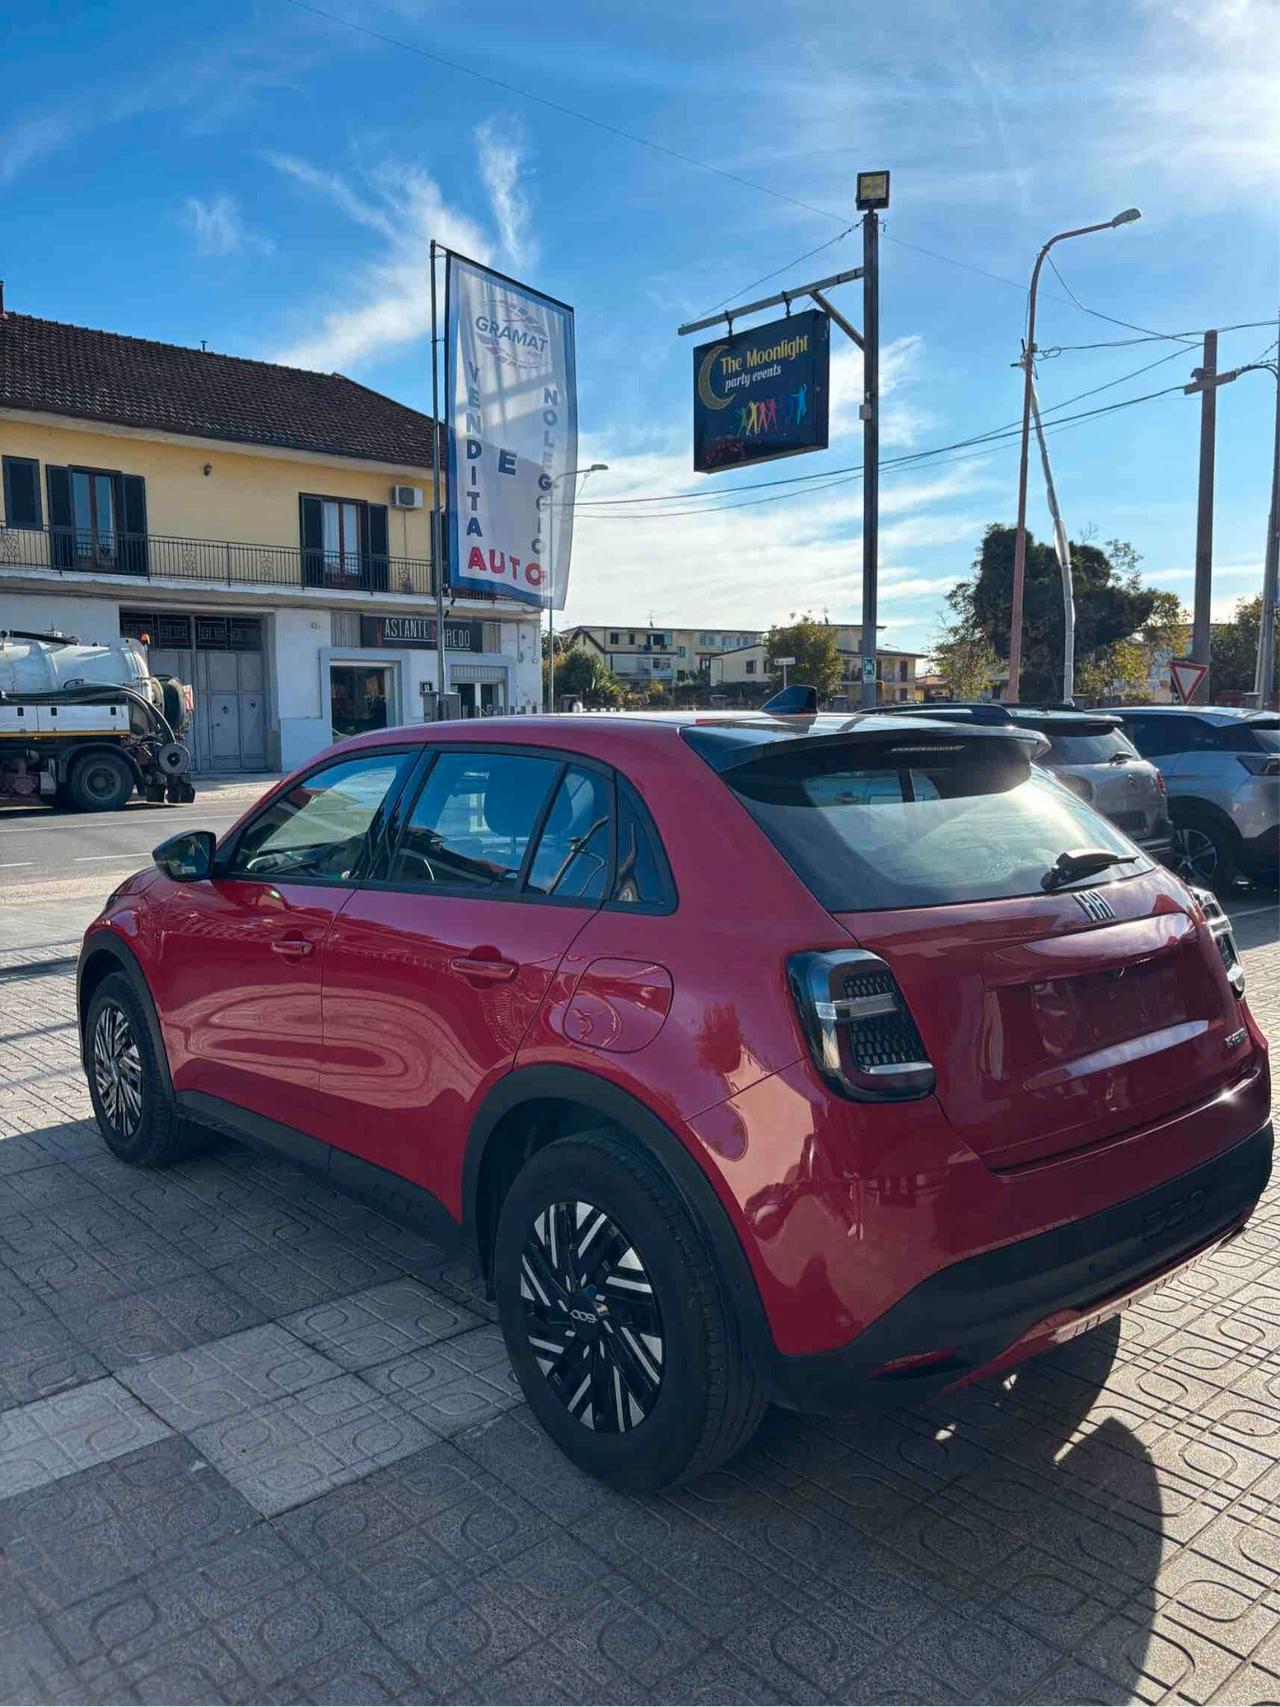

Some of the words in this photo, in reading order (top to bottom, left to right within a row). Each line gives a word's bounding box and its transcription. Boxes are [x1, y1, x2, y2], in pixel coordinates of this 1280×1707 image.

[475, 316, 548, 352] GRAMAT
[720, 355, 742, 375] The
[746, 334, 809, 368] Moonlight
[724, 373, 750, 393] party
[752, 364, 781, 381] events
[466, 360, 483, 537] VENDITA
[498, 447, 517, 476] E
[468, 546, 546, 586] AUTO
